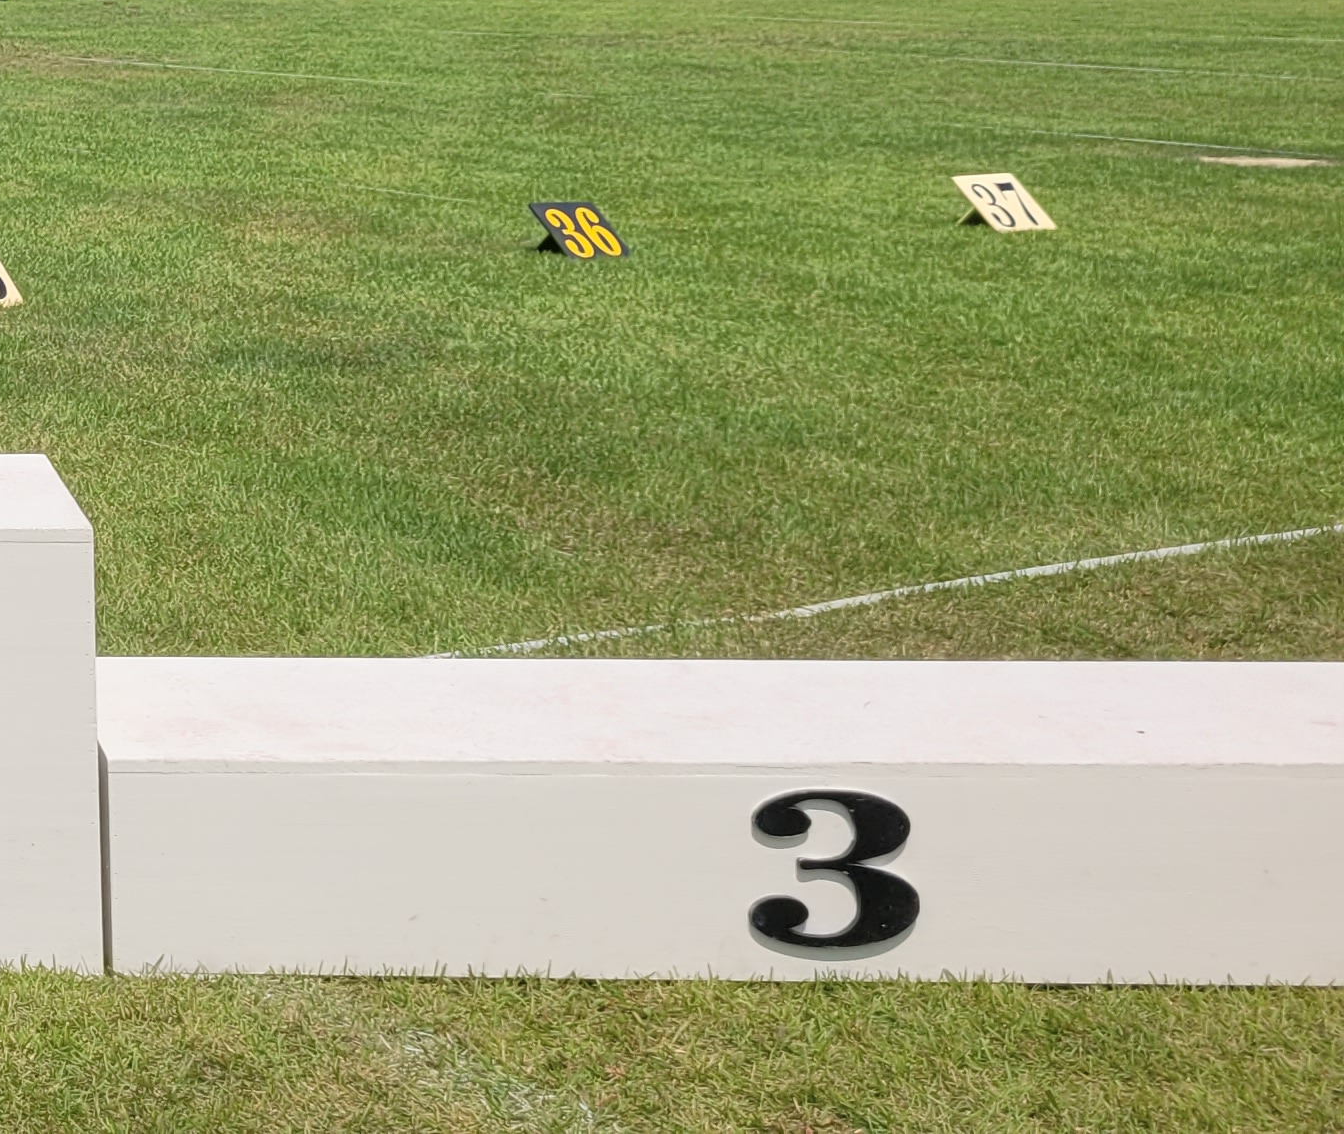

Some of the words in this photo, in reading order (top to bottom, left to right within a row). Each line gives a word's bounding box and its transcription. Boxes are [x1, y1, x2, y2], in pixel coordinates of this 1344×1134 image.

[971, 182, 1039, 227] 37
[545, 207, 622, 258] 36
[748, 787, 921, 962] 3
